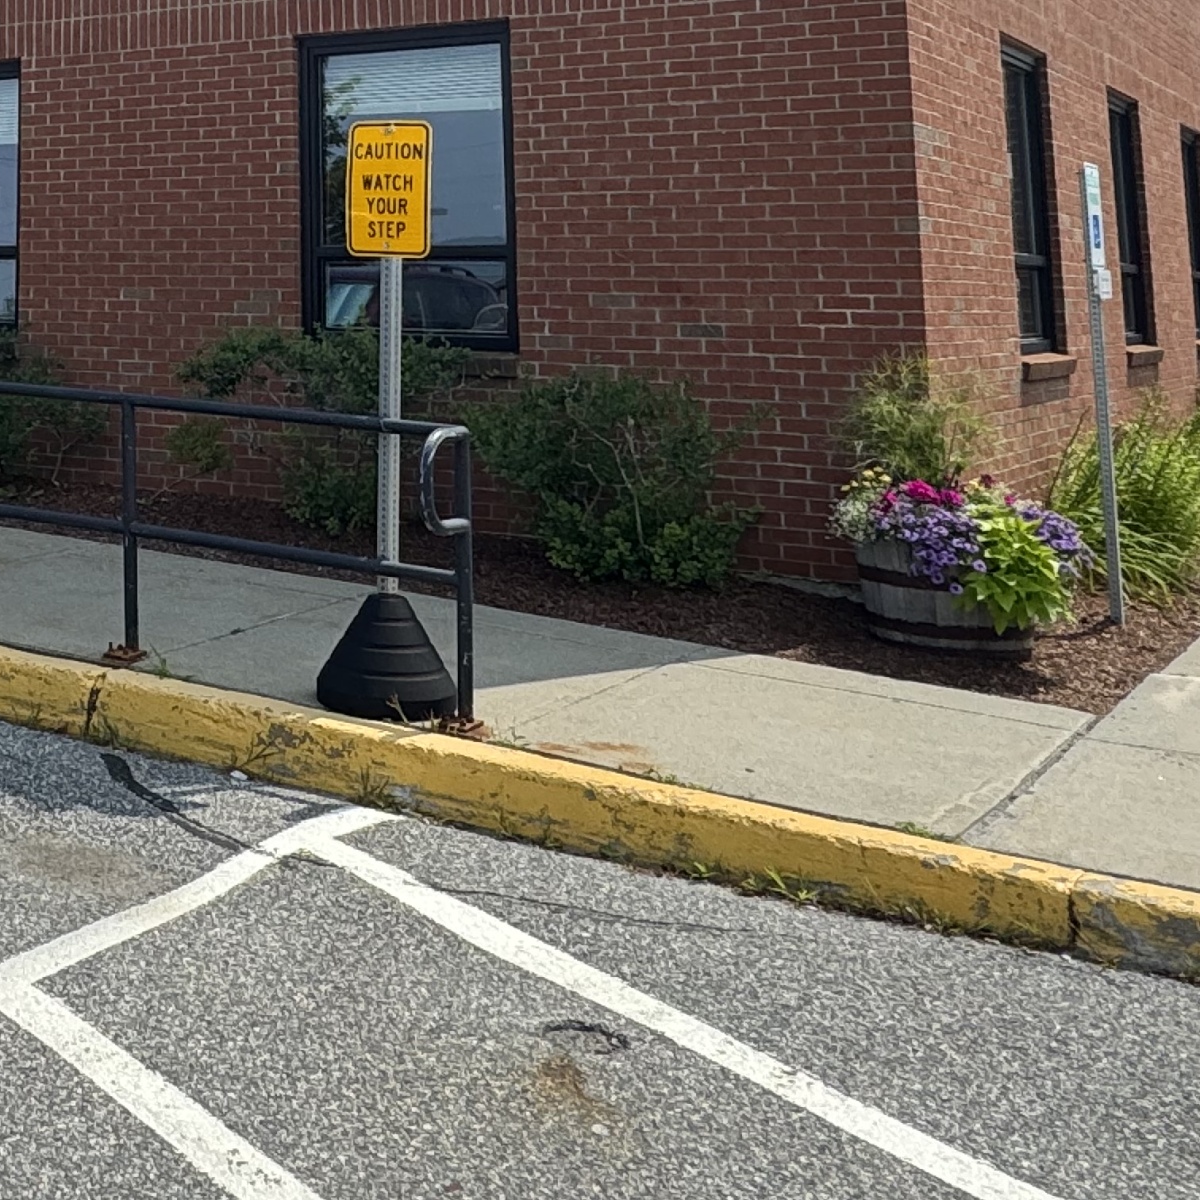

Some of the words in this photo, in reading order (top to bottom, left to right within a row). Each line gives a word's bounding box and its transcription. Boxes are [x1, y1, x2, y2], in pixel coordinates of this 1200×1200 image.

[355, 143, 423, 160] CAUTION
[362, 174, 413, 192] WATCH
[366, 197, 408, 215] YOUR
[367, 221, 406, 239] STEP
